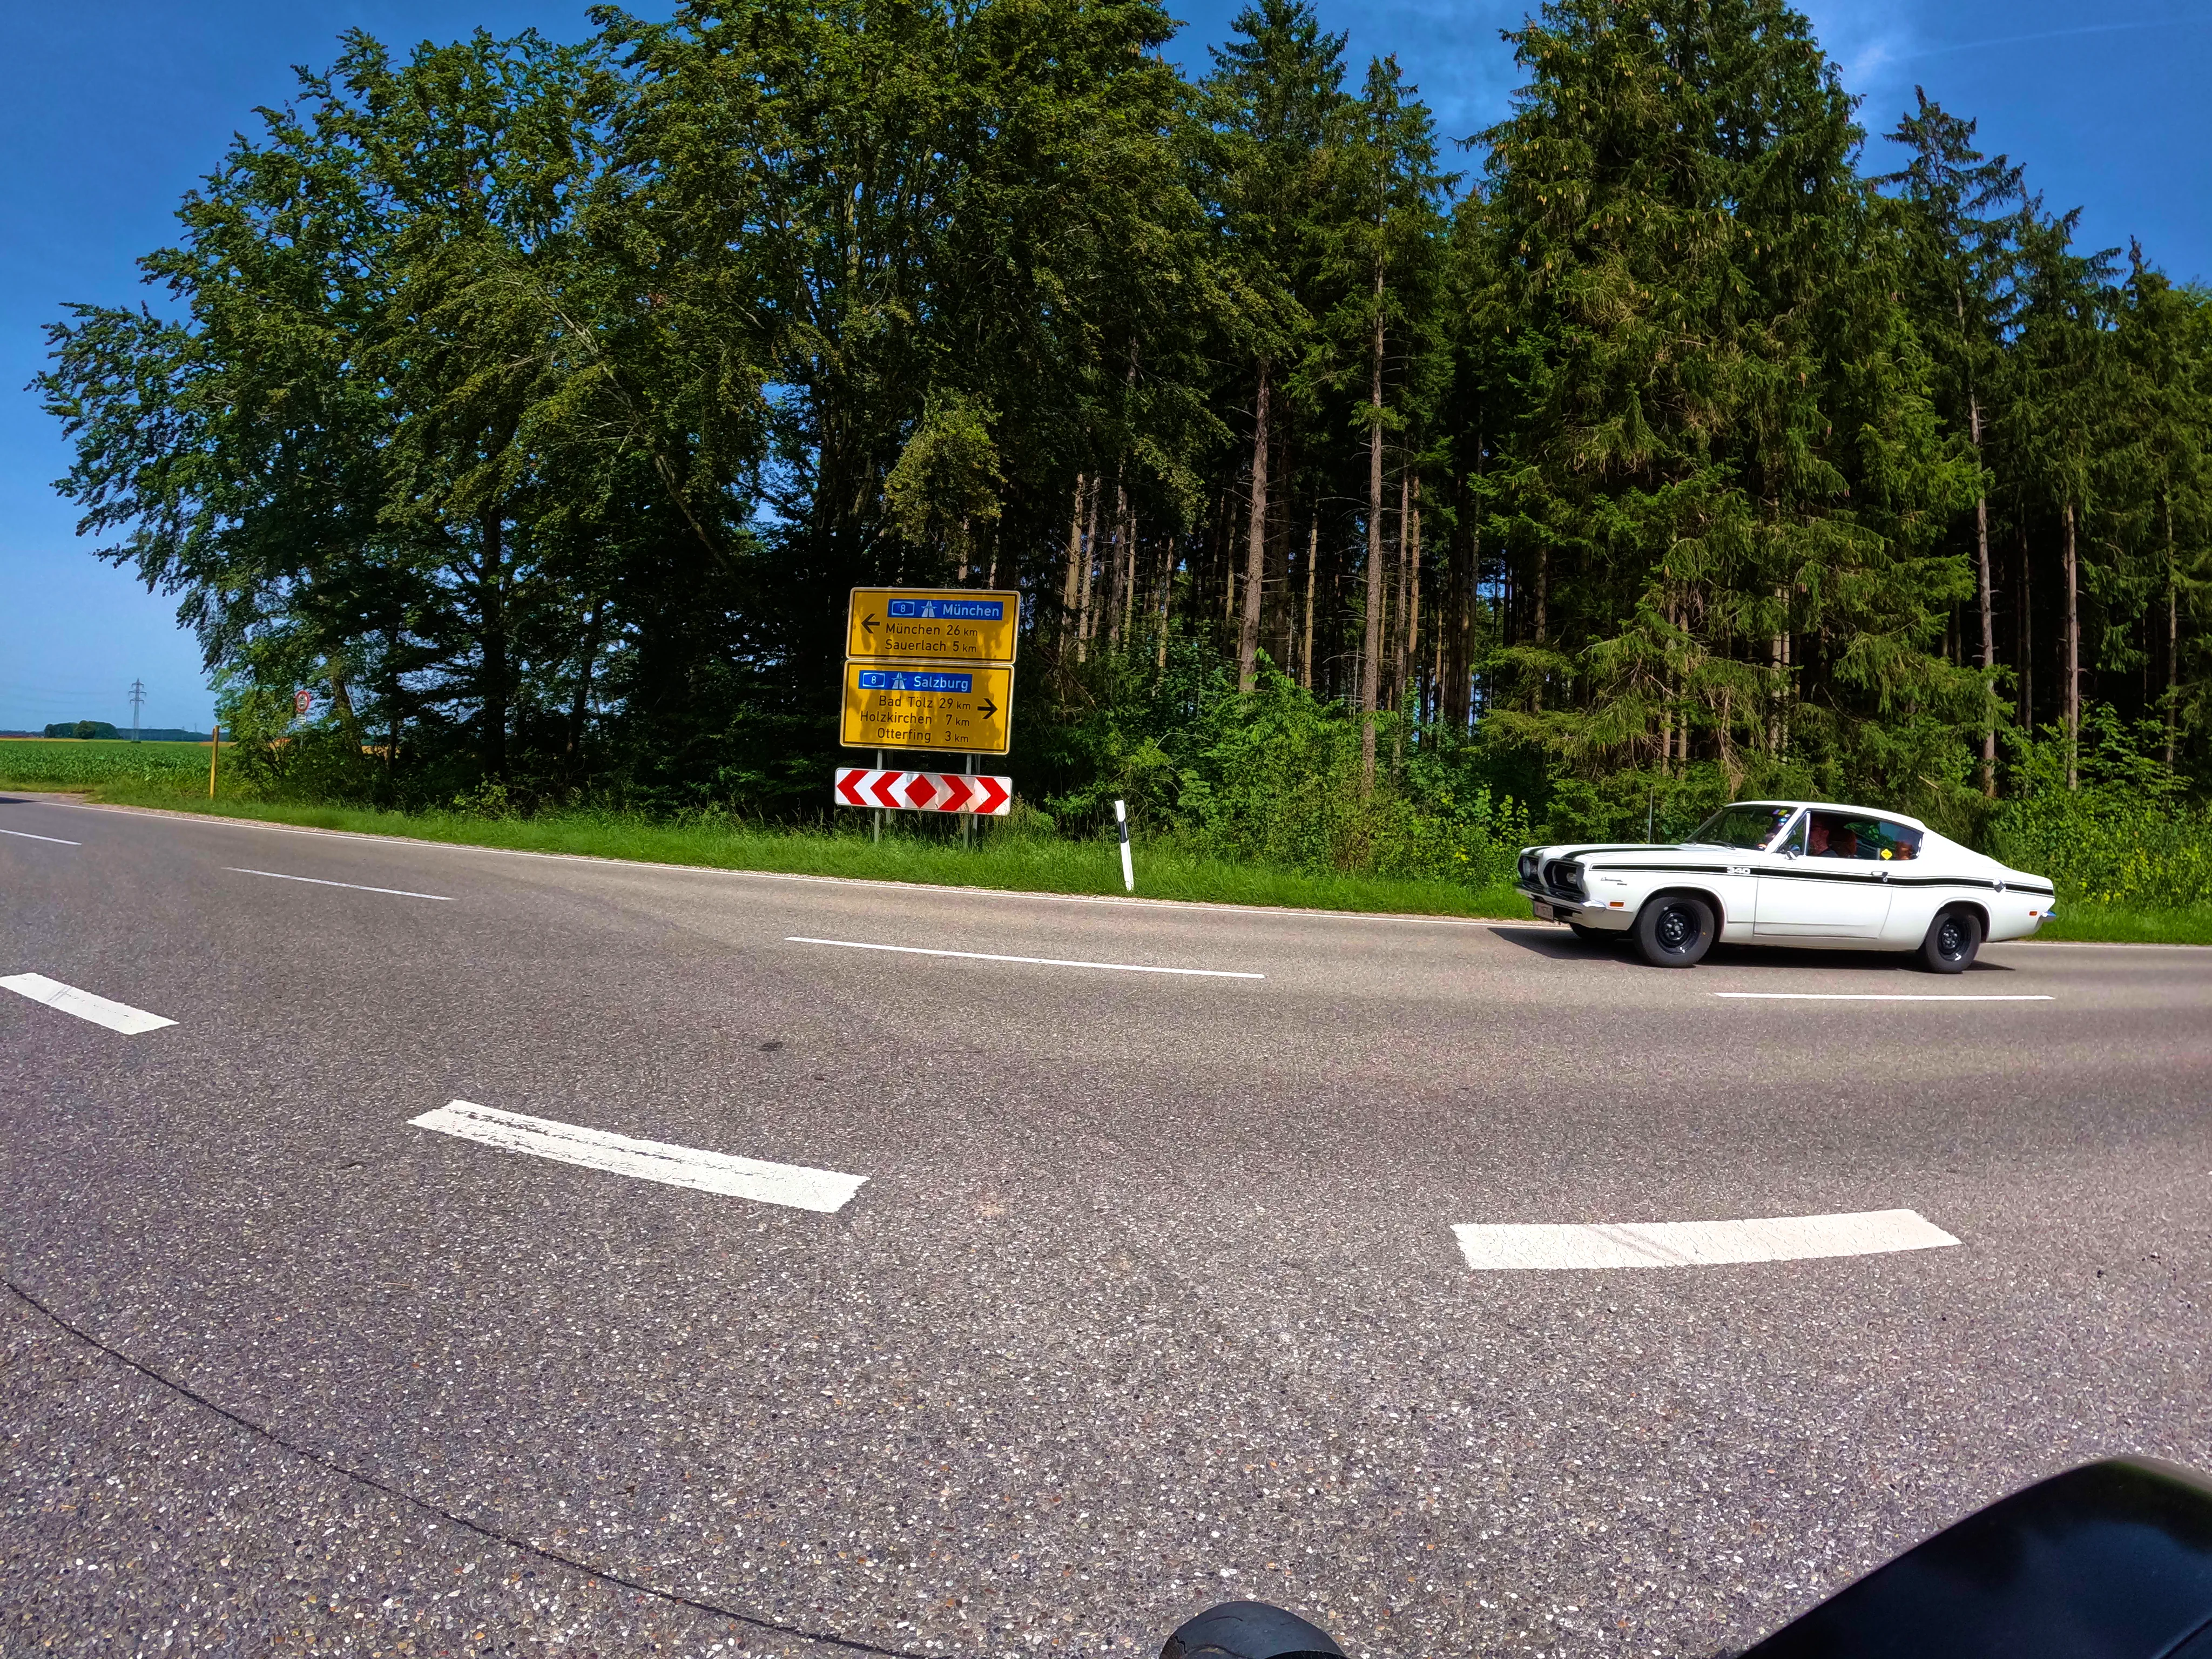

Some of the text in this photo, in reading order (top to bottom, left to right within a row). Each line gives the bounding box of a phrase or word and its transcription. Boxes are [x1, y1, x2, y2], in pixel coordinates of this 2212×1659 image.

[900, 604, 1000, 617] 8 München
[886, 623, 978, 636] München 26 km
[885, 639, 977, 653] Sauerlach 5 km
[871, 676, 968, 692] 8 Salzburg
[879, 696, 971, 710] Bad Tölz 29 km
[860, 710, 970, 726] Holzkirchen 7 km
[878, 728, 969, 743] Otterfing 3 km
